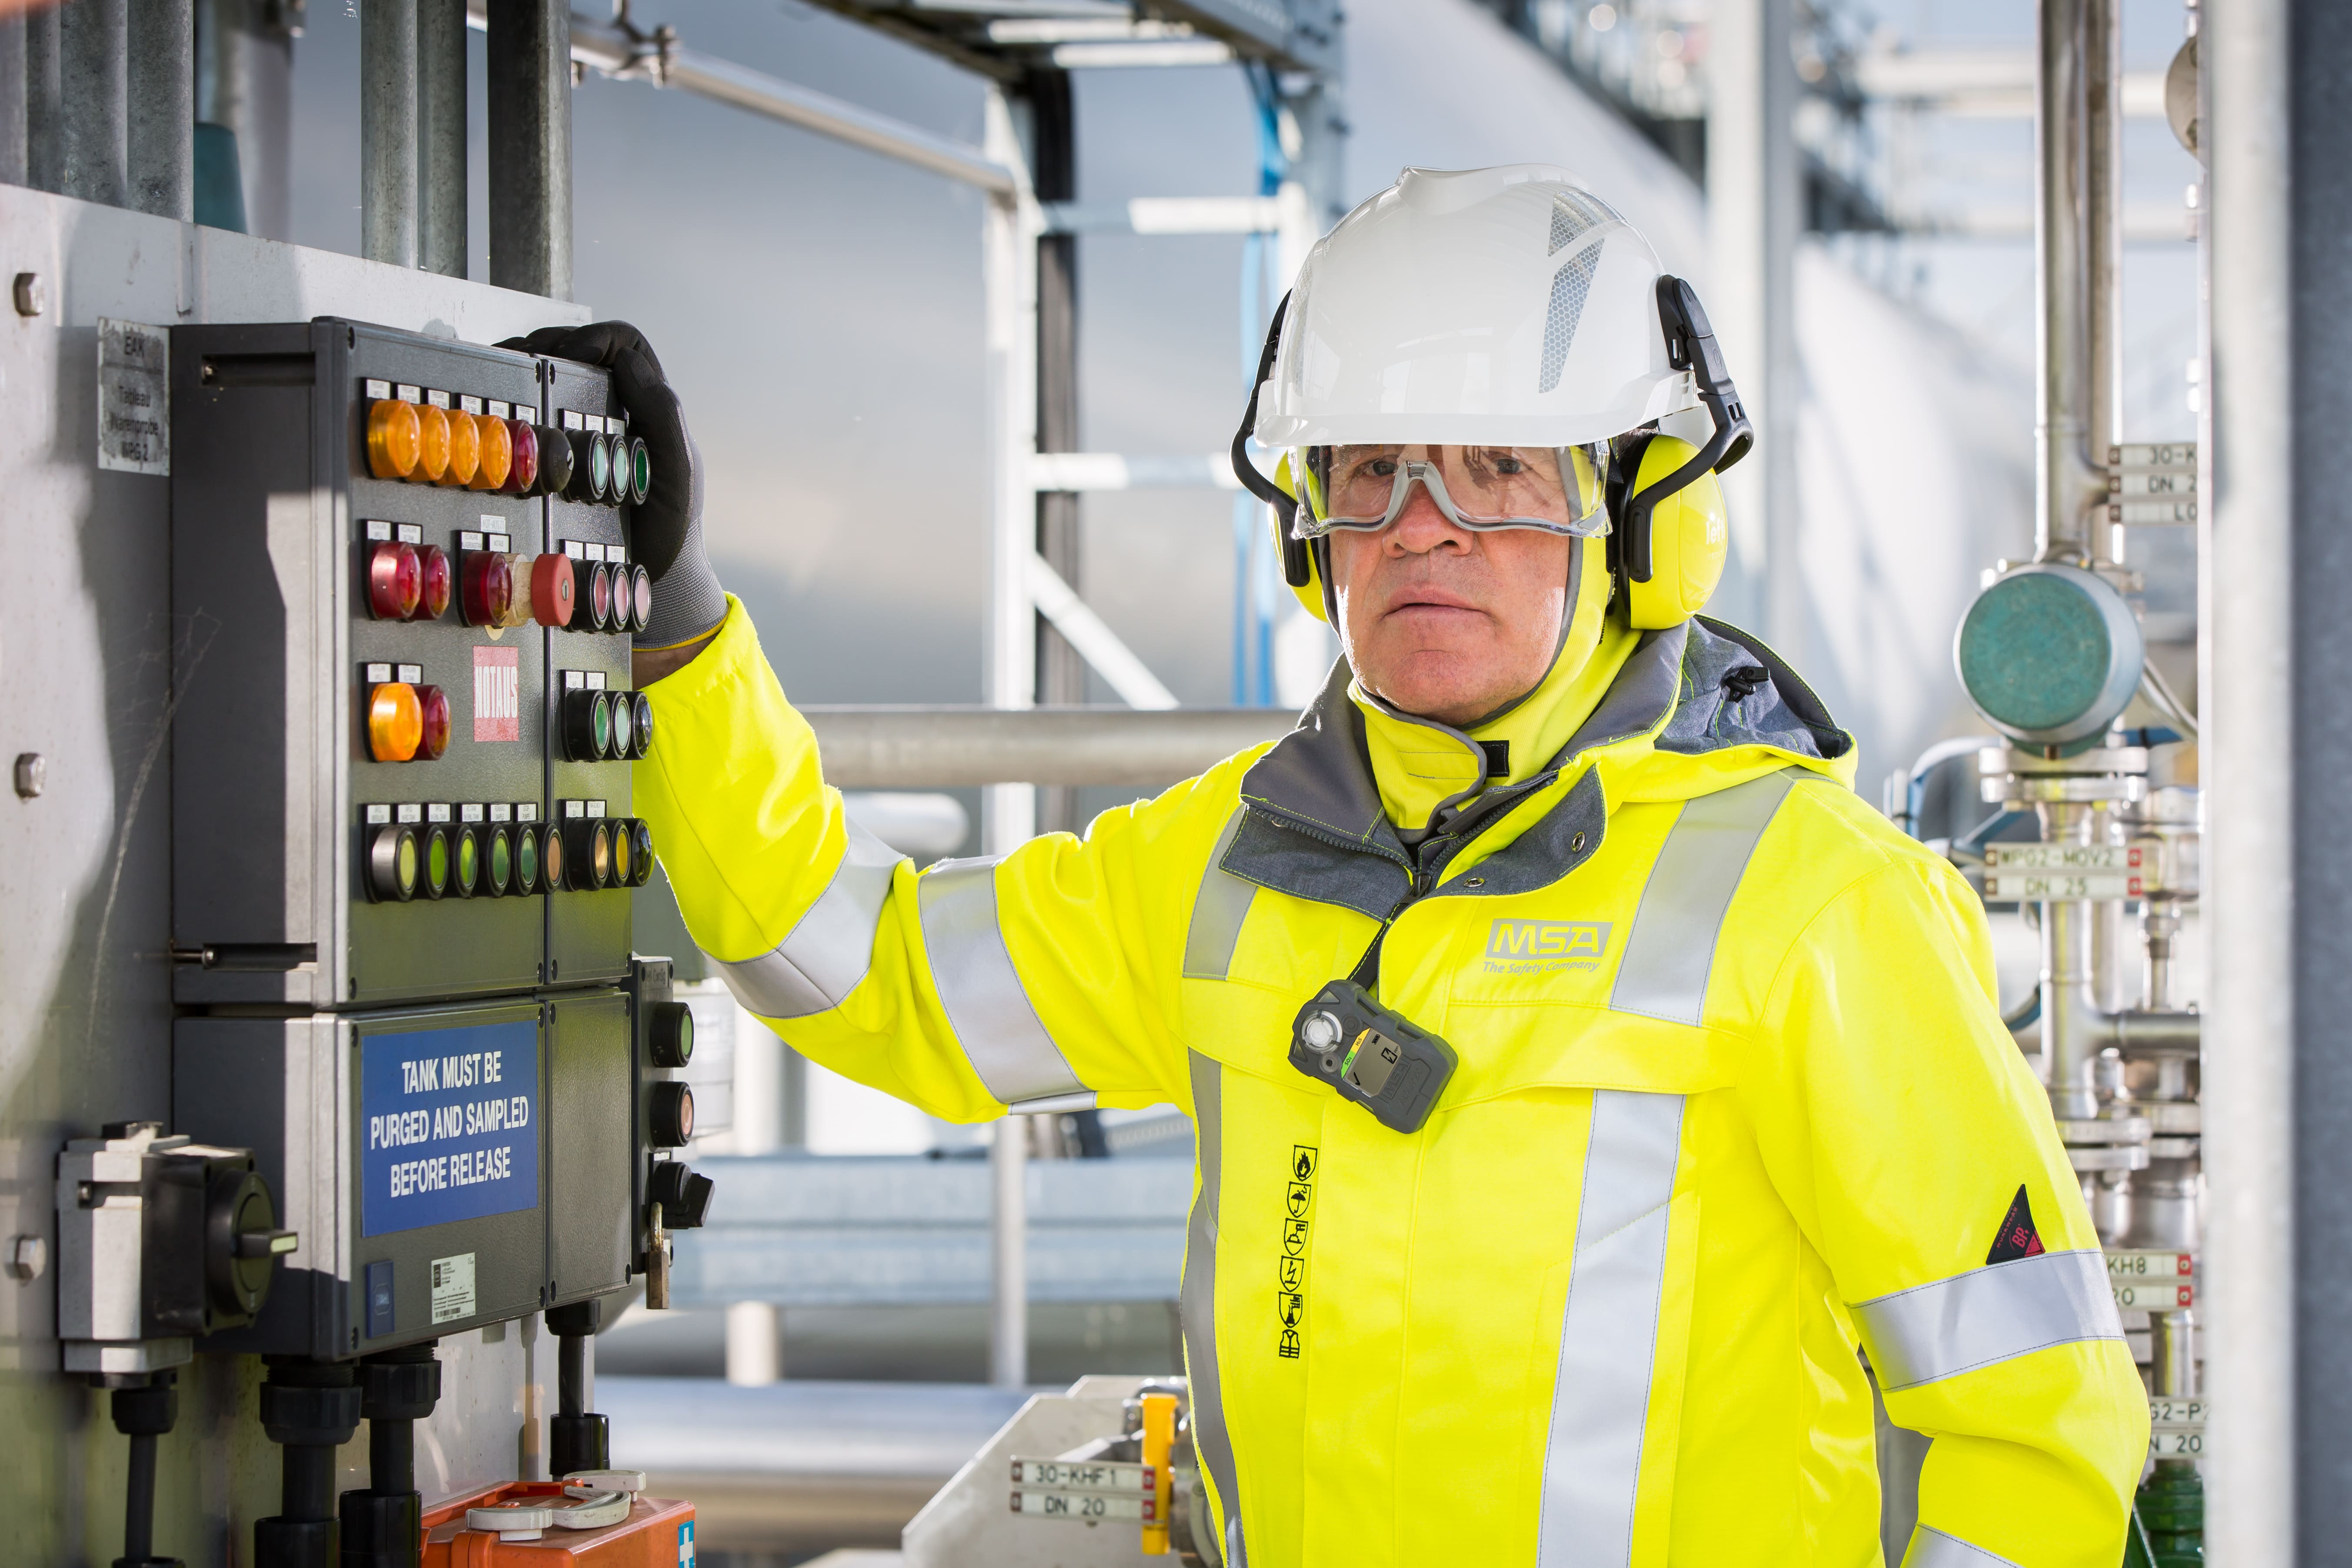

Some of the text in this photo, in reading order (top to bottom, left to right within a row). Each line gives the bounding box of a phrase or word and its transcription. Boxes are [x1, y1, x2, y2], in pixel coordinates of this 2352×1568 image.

[124, 336, 145, 358] EAK
[2148, 474, 2173, 494] DN
[475, 666, 518, 718] NOTAUS
[2025, 877, 2049, 895] DN
[1493, 923, 1599, 955] MSA
[1483, 961, 1600, 976] The Safety Company
[402, 1051, 501, 1094] TANK MUST BE
[371, 1096, 528, 1150] PURGED AND SAMPLED
[391, 1146, 511, 1197] BEFORE RELEASE
[2177, 1435, 2202, 1453] 20
[1045, 1495, 1106, 1517] DN 20
